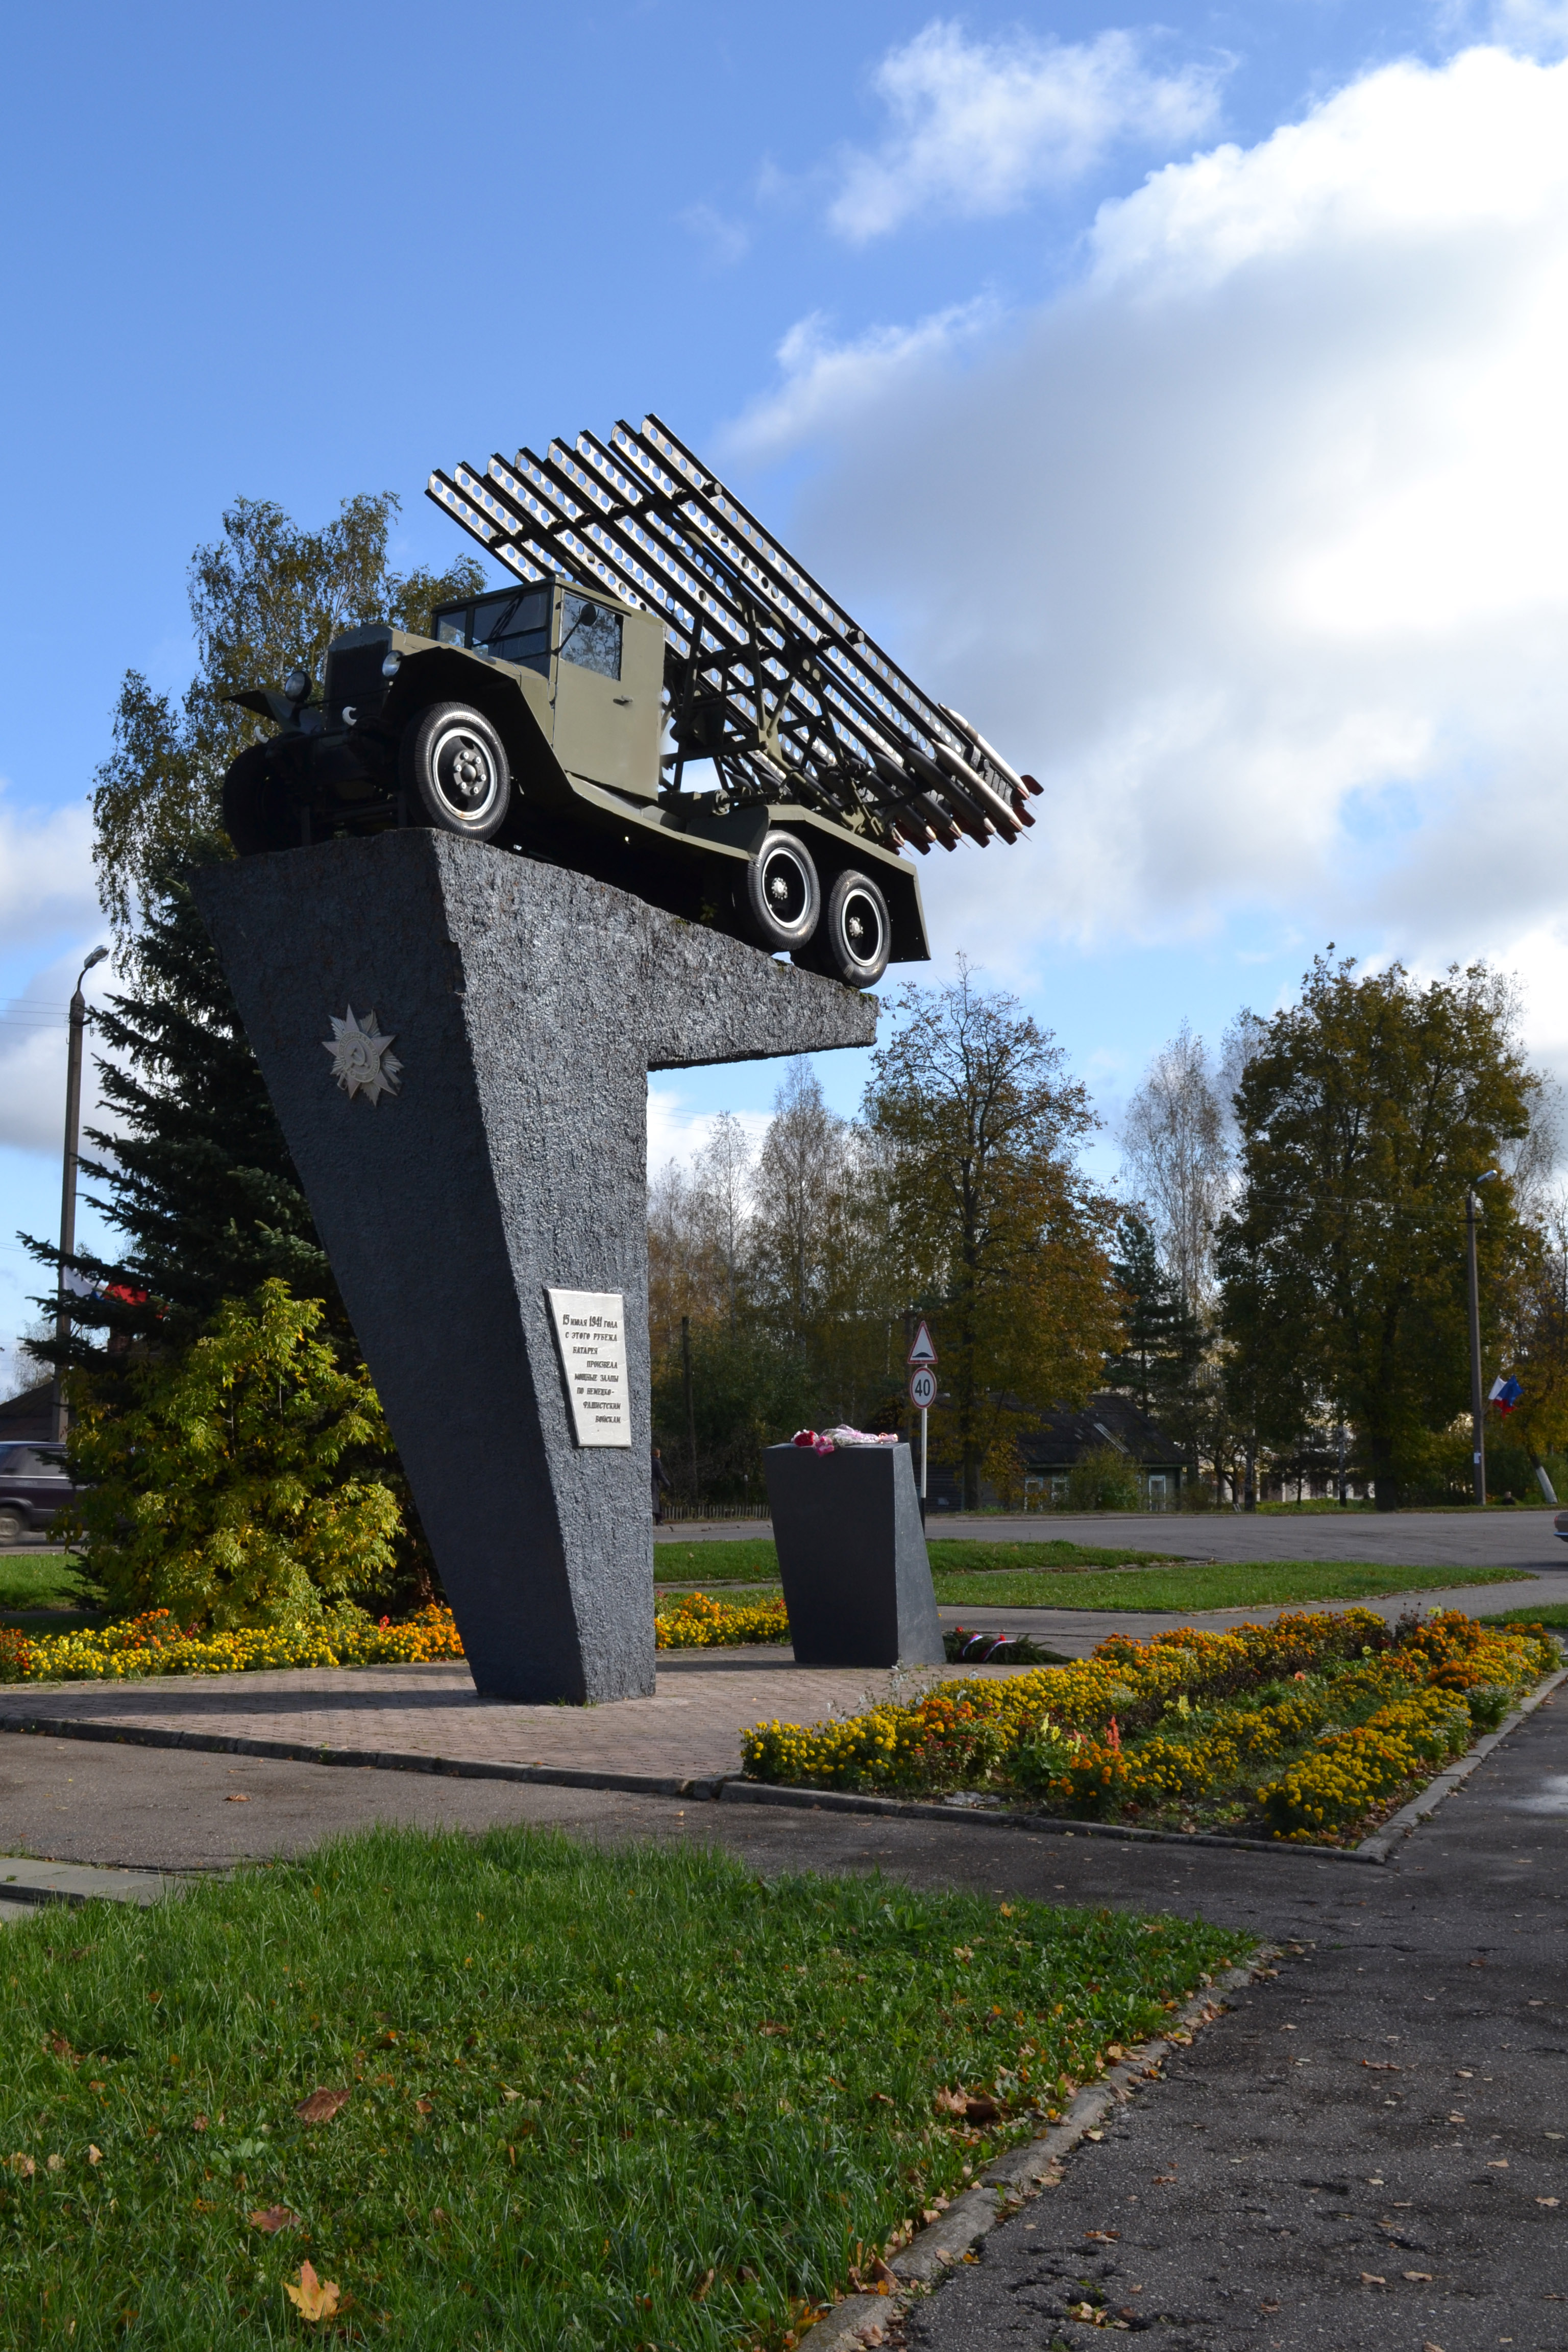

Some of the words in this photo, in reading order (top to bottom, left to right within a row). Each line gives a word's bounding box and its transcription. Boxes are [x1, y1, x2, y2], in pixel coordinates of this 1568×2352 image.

[562, 1314, 570, 1325] 15
[570, 1318, 587, 1327] ИЮЛЯ
[589, 1315, 602, 1327] 1941
[604, 1320, 618, 1328] ГОДА
[572, 1332, 591, 1340] ЭТОГО
[593, 1333, 618, 1341] РУБЕЖА
[573, 1346, 598, 1355] БАТАРЕЯ
[586, 1360, 618, 1369] ПРОИЗВЕЛА
[574, 1373, 598, 1381] МОЩНЫЕ
[600, 1374, 619, 1382] ЗАЛПЫ
[586, 1387, 615, 1396] НЕМЕЦКО-
[915, 1379, 930, 1396] 40
[583, 1401, 621, 1410] ФАШИСТСКИМ
[595, 1414, 621, 1424] ВОЙСКАМ
